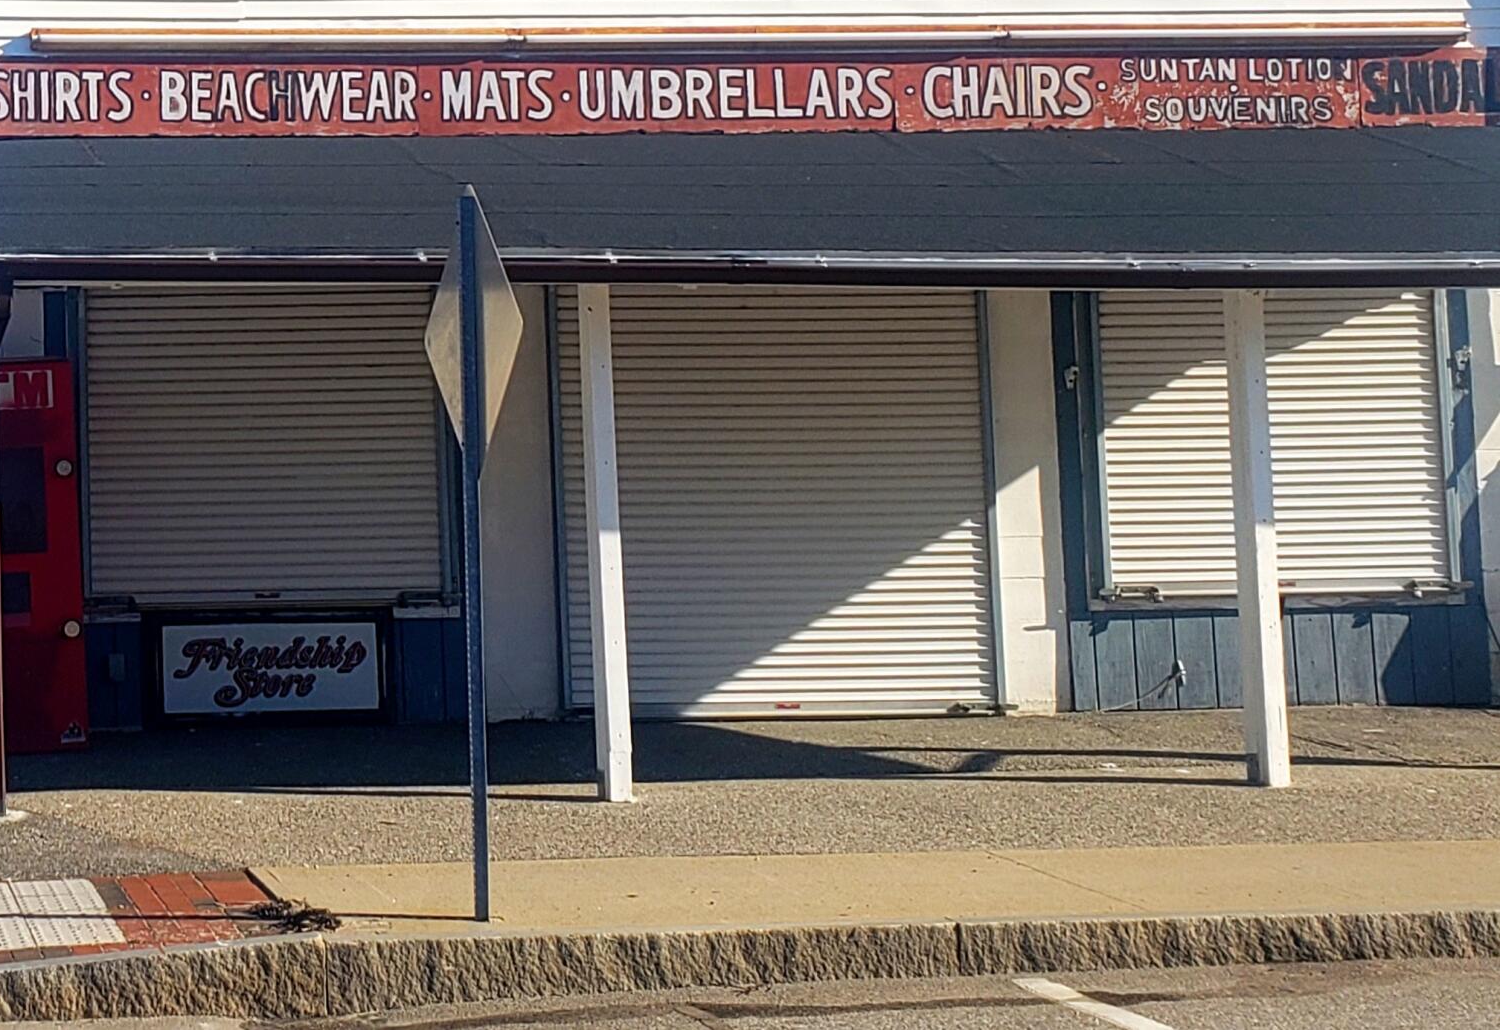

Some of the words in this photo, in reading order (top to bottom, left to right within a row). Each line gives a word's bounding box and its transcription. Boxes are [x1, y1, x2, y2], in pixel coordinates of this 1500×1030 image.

[1120, 56, 1238, 82] SUNTAN
[1248, 56, 1353, 82] LOTION
[158, 67, 418, 123] BEACHWEAR
[440, 68, 556, 122] MATS
[577, 66, 895, 120] UMBRELLARS
[922, 63, 1095, 120] CHAIRS
[1143, 95, 1334, 124] SOUVENIRS
[173, 634, 368, 679] Friendship
[213, 669, 317, 708] Store
